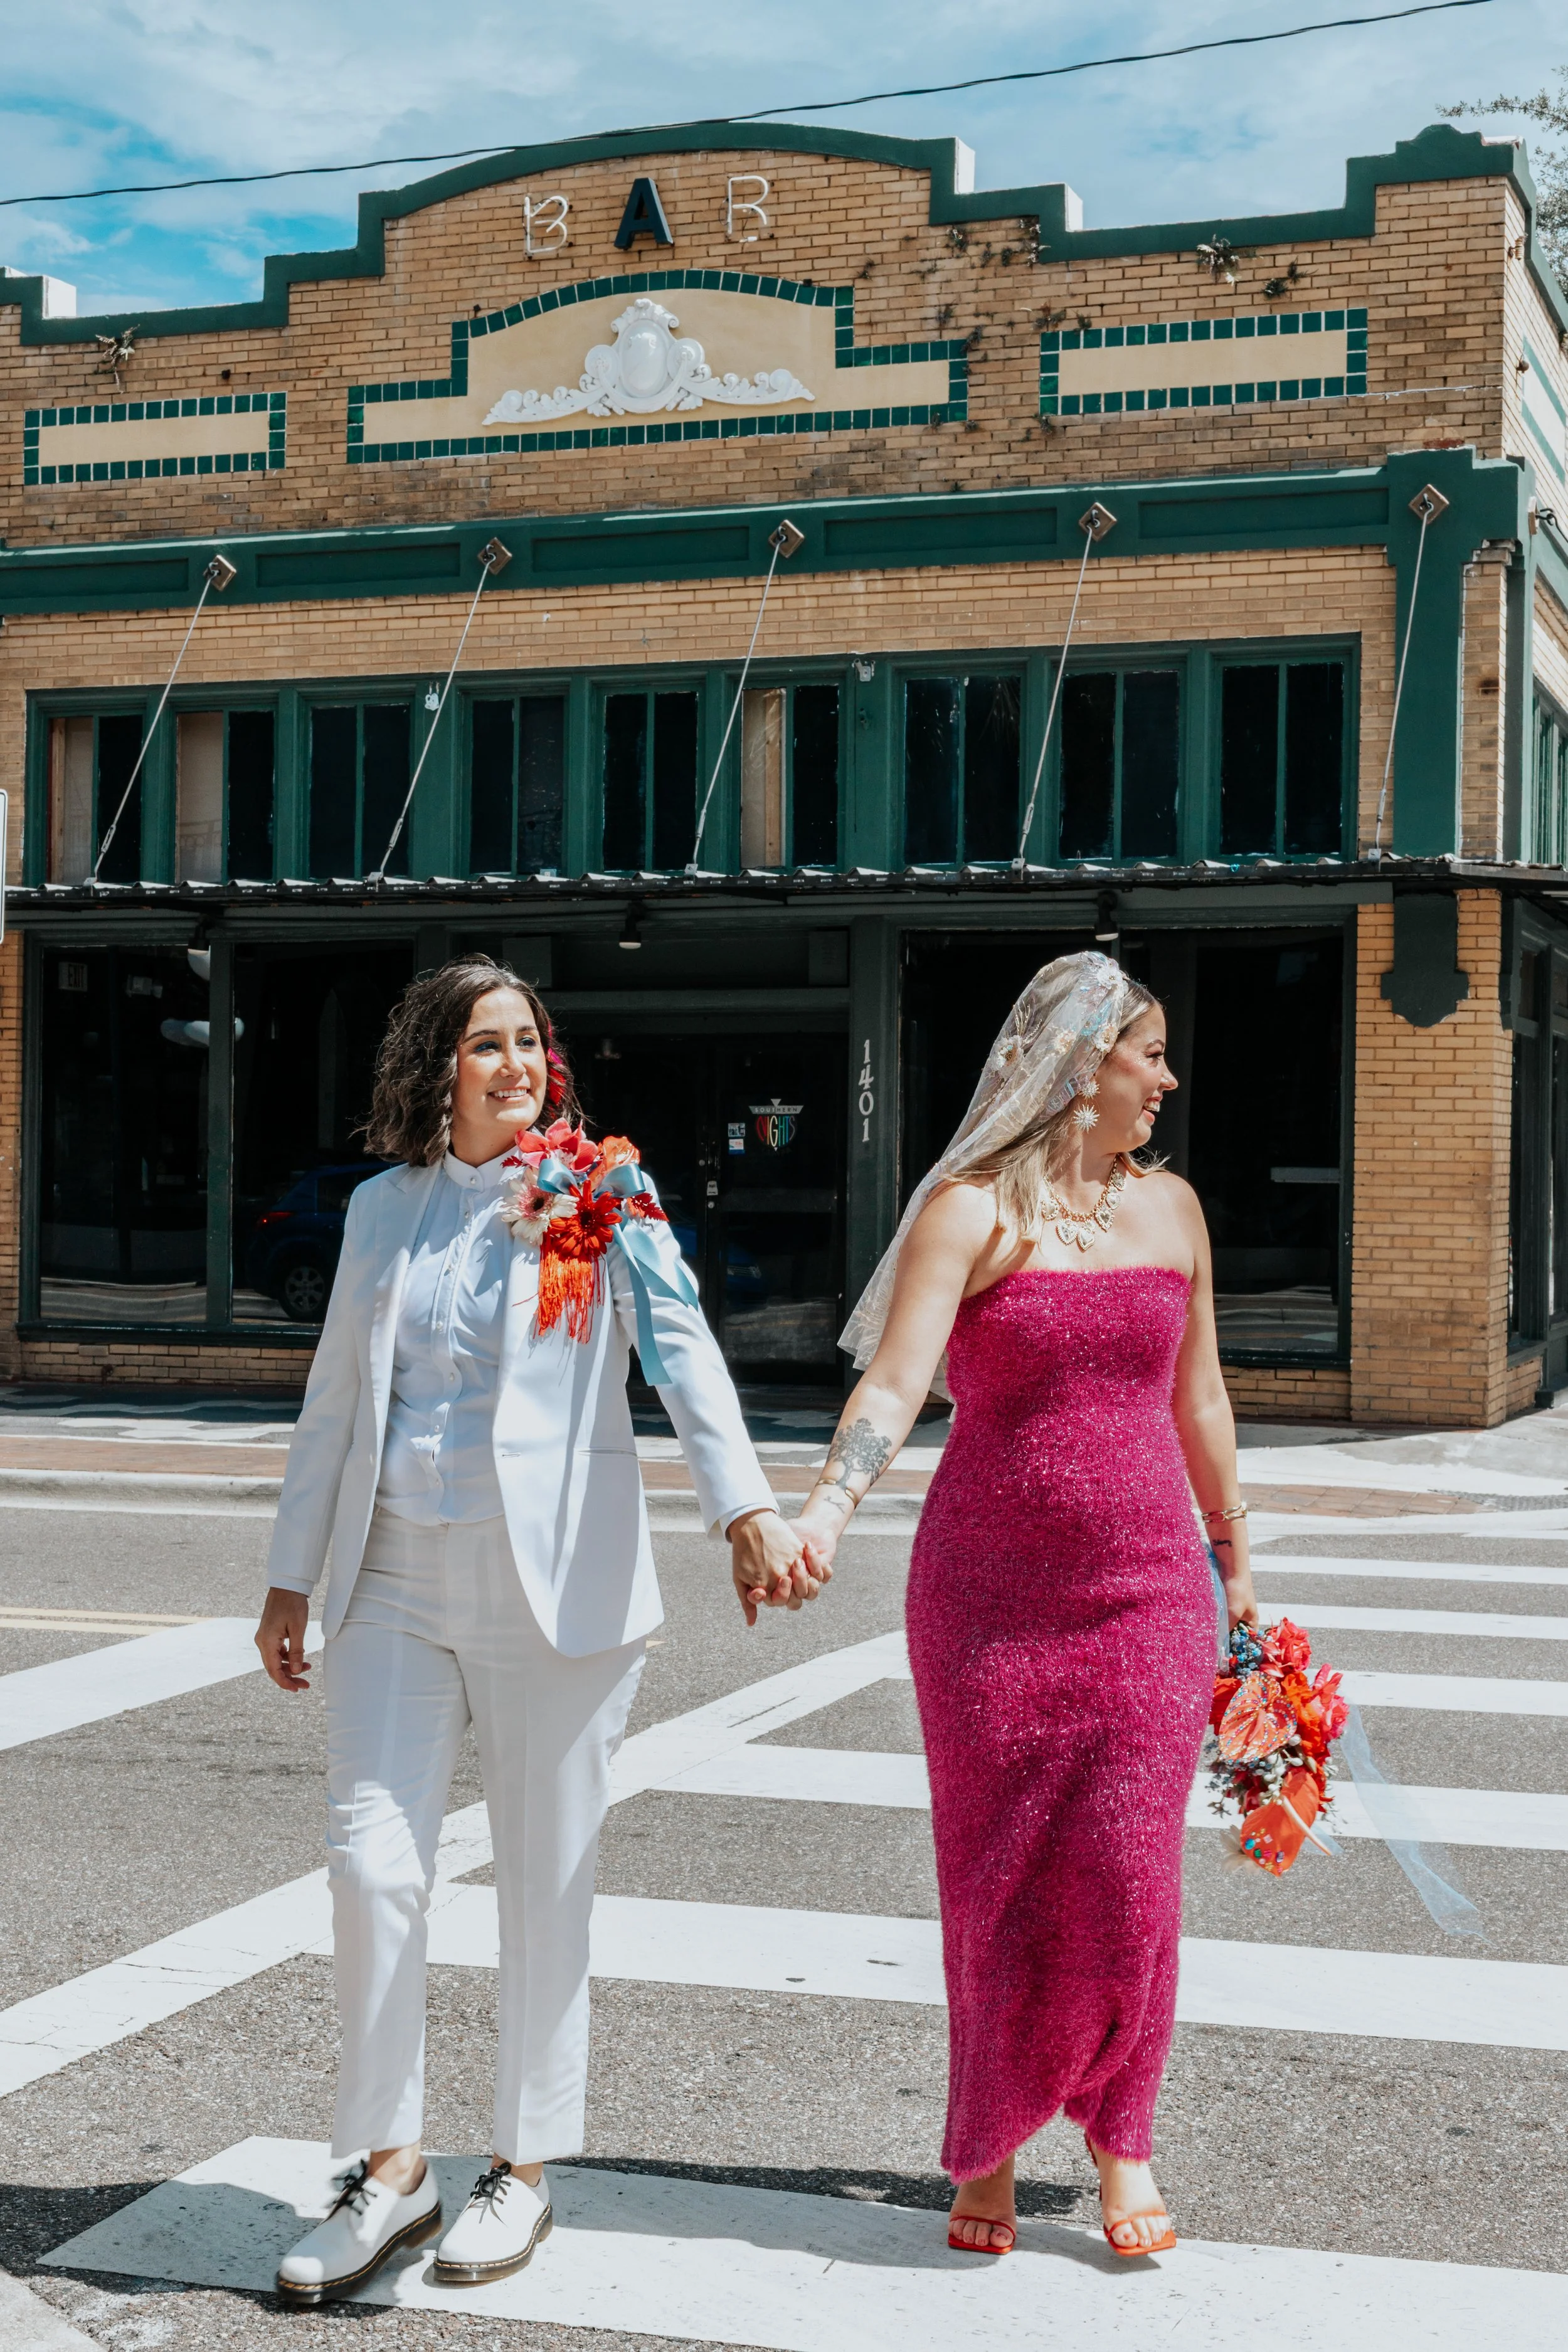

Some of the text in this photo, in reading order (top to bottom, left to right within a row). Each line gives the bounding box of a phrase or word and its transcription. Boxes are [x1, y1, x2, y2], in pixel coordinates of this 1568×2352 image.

[524, 175, 768, 254] BAR
[68, 963, 84, 988] EXIT
[858, 1039, 874, 1142] 1401
[756, 1115, 795, 1147] NIGHTS
